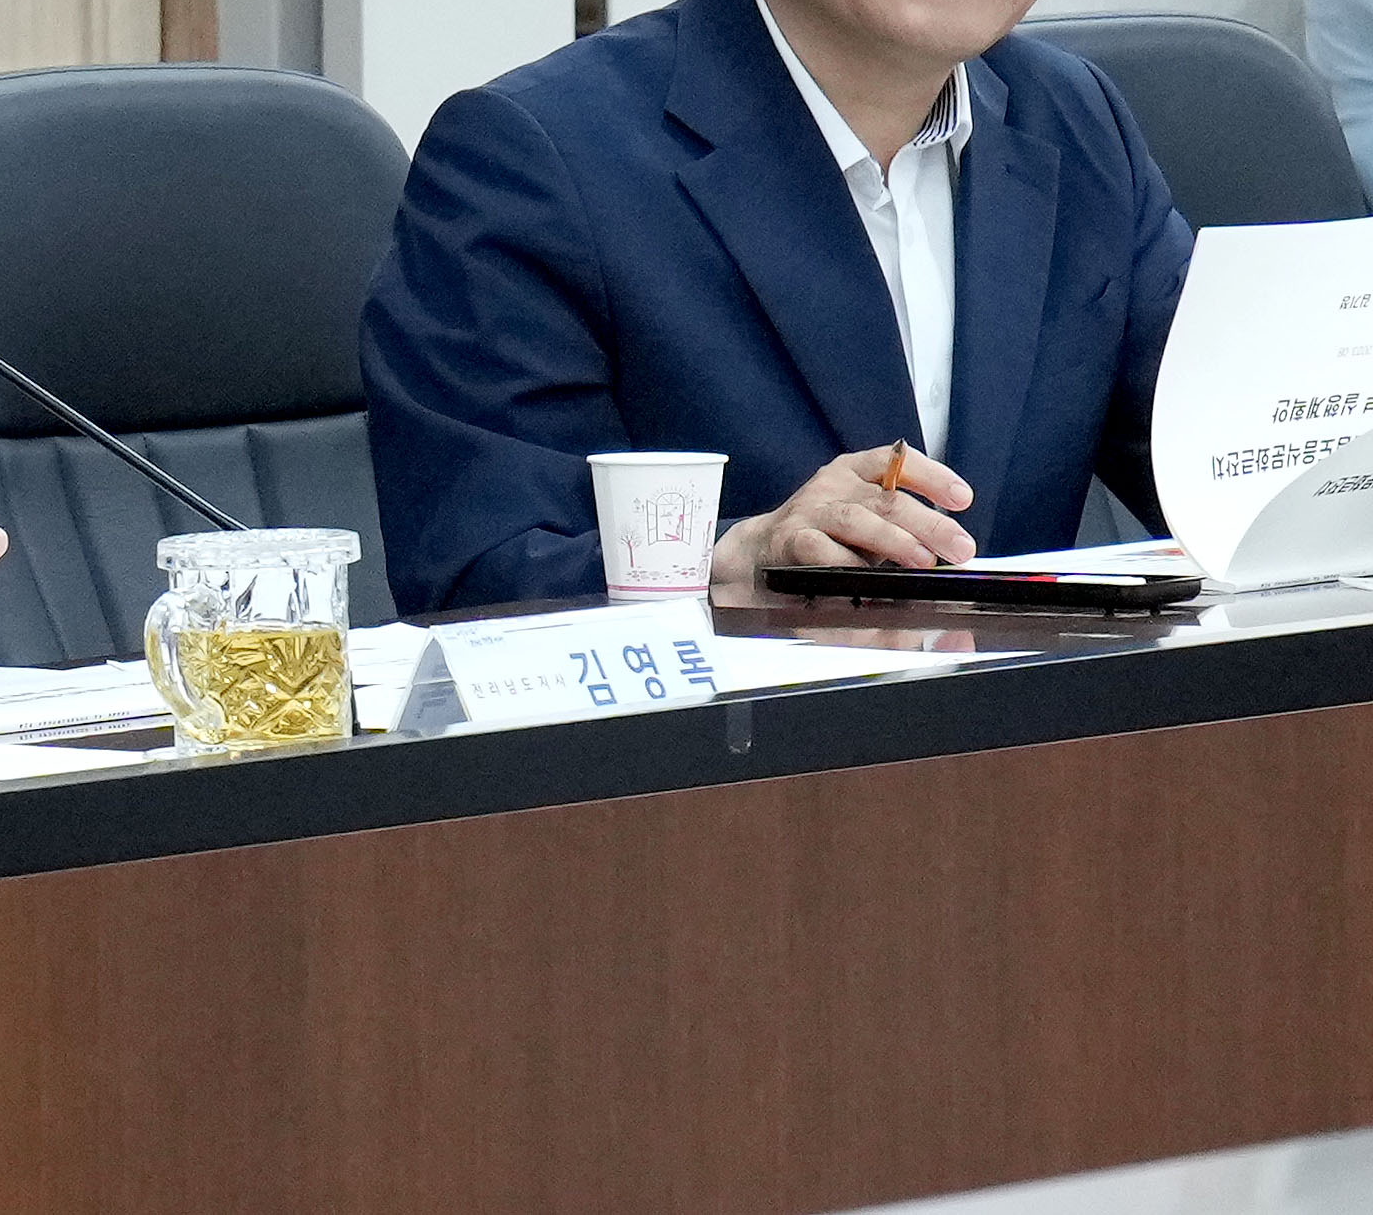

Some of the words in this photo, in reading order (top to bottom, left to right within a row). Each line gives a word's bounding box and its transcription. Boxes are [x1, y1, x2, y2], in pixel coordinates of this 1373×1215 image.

[1272, 392, 1360, 424] 실행계획안
[470, 673, 566, 699] 전라남도지사
[569, 639, 719, 707] 김영록
